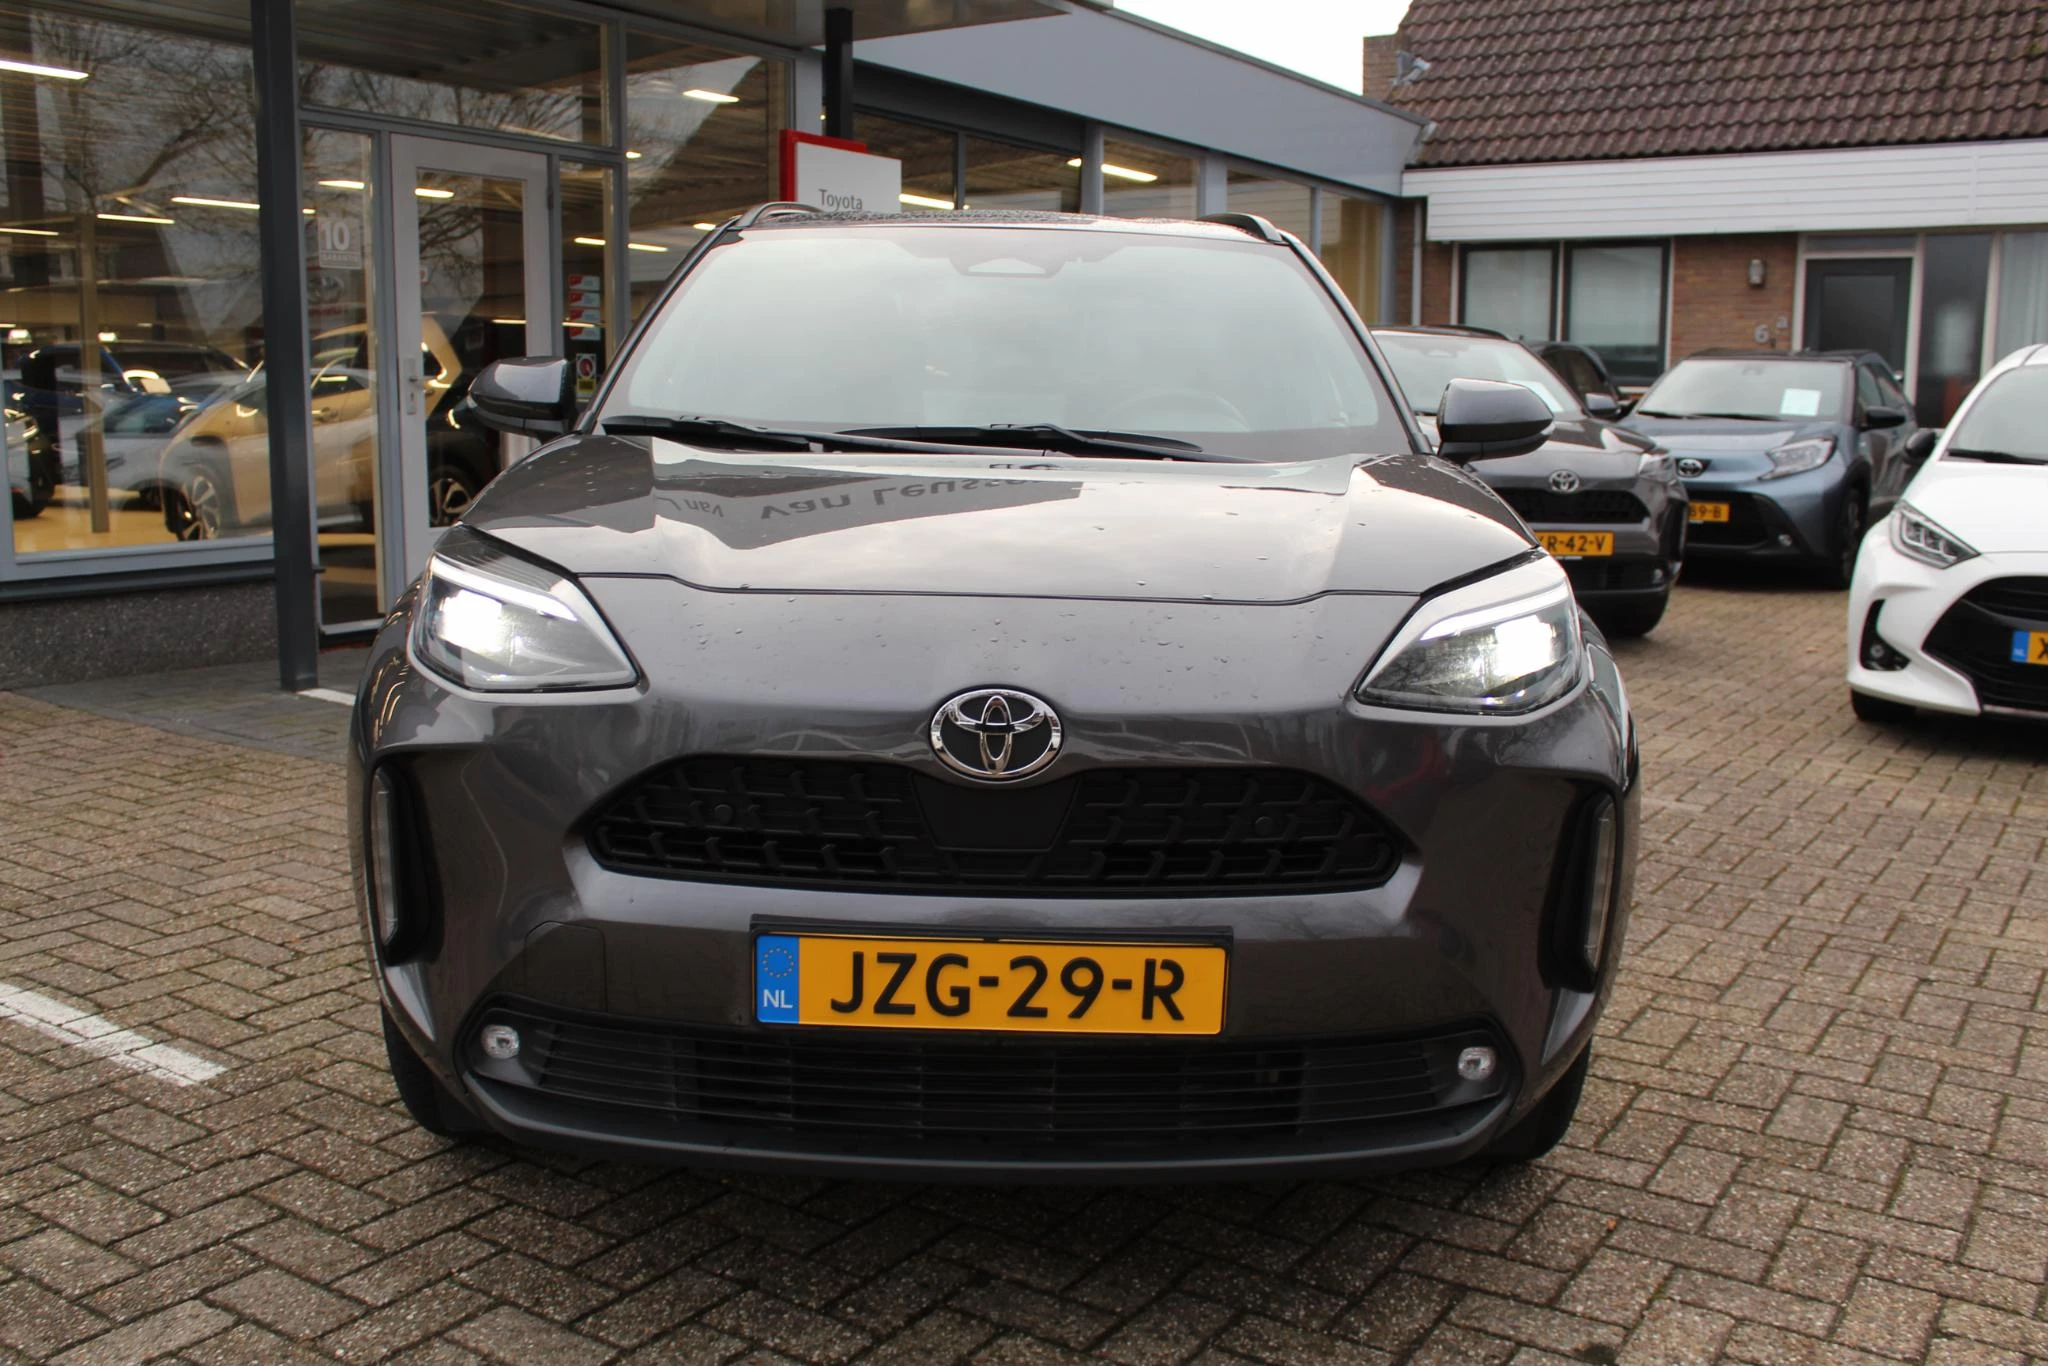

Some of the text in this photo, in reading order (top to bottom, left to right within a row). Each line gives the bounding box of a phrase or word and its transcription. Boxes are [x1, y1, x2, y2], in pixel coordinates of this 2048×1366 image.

[818, 188, 863, 213] Toyota
[320, 222, 351, 251] 10
[1755, 324, 1769, 343] 6
[830, 950, 1185, 1021] JZG-29-R
[763, 988, 793, 1009] NL
